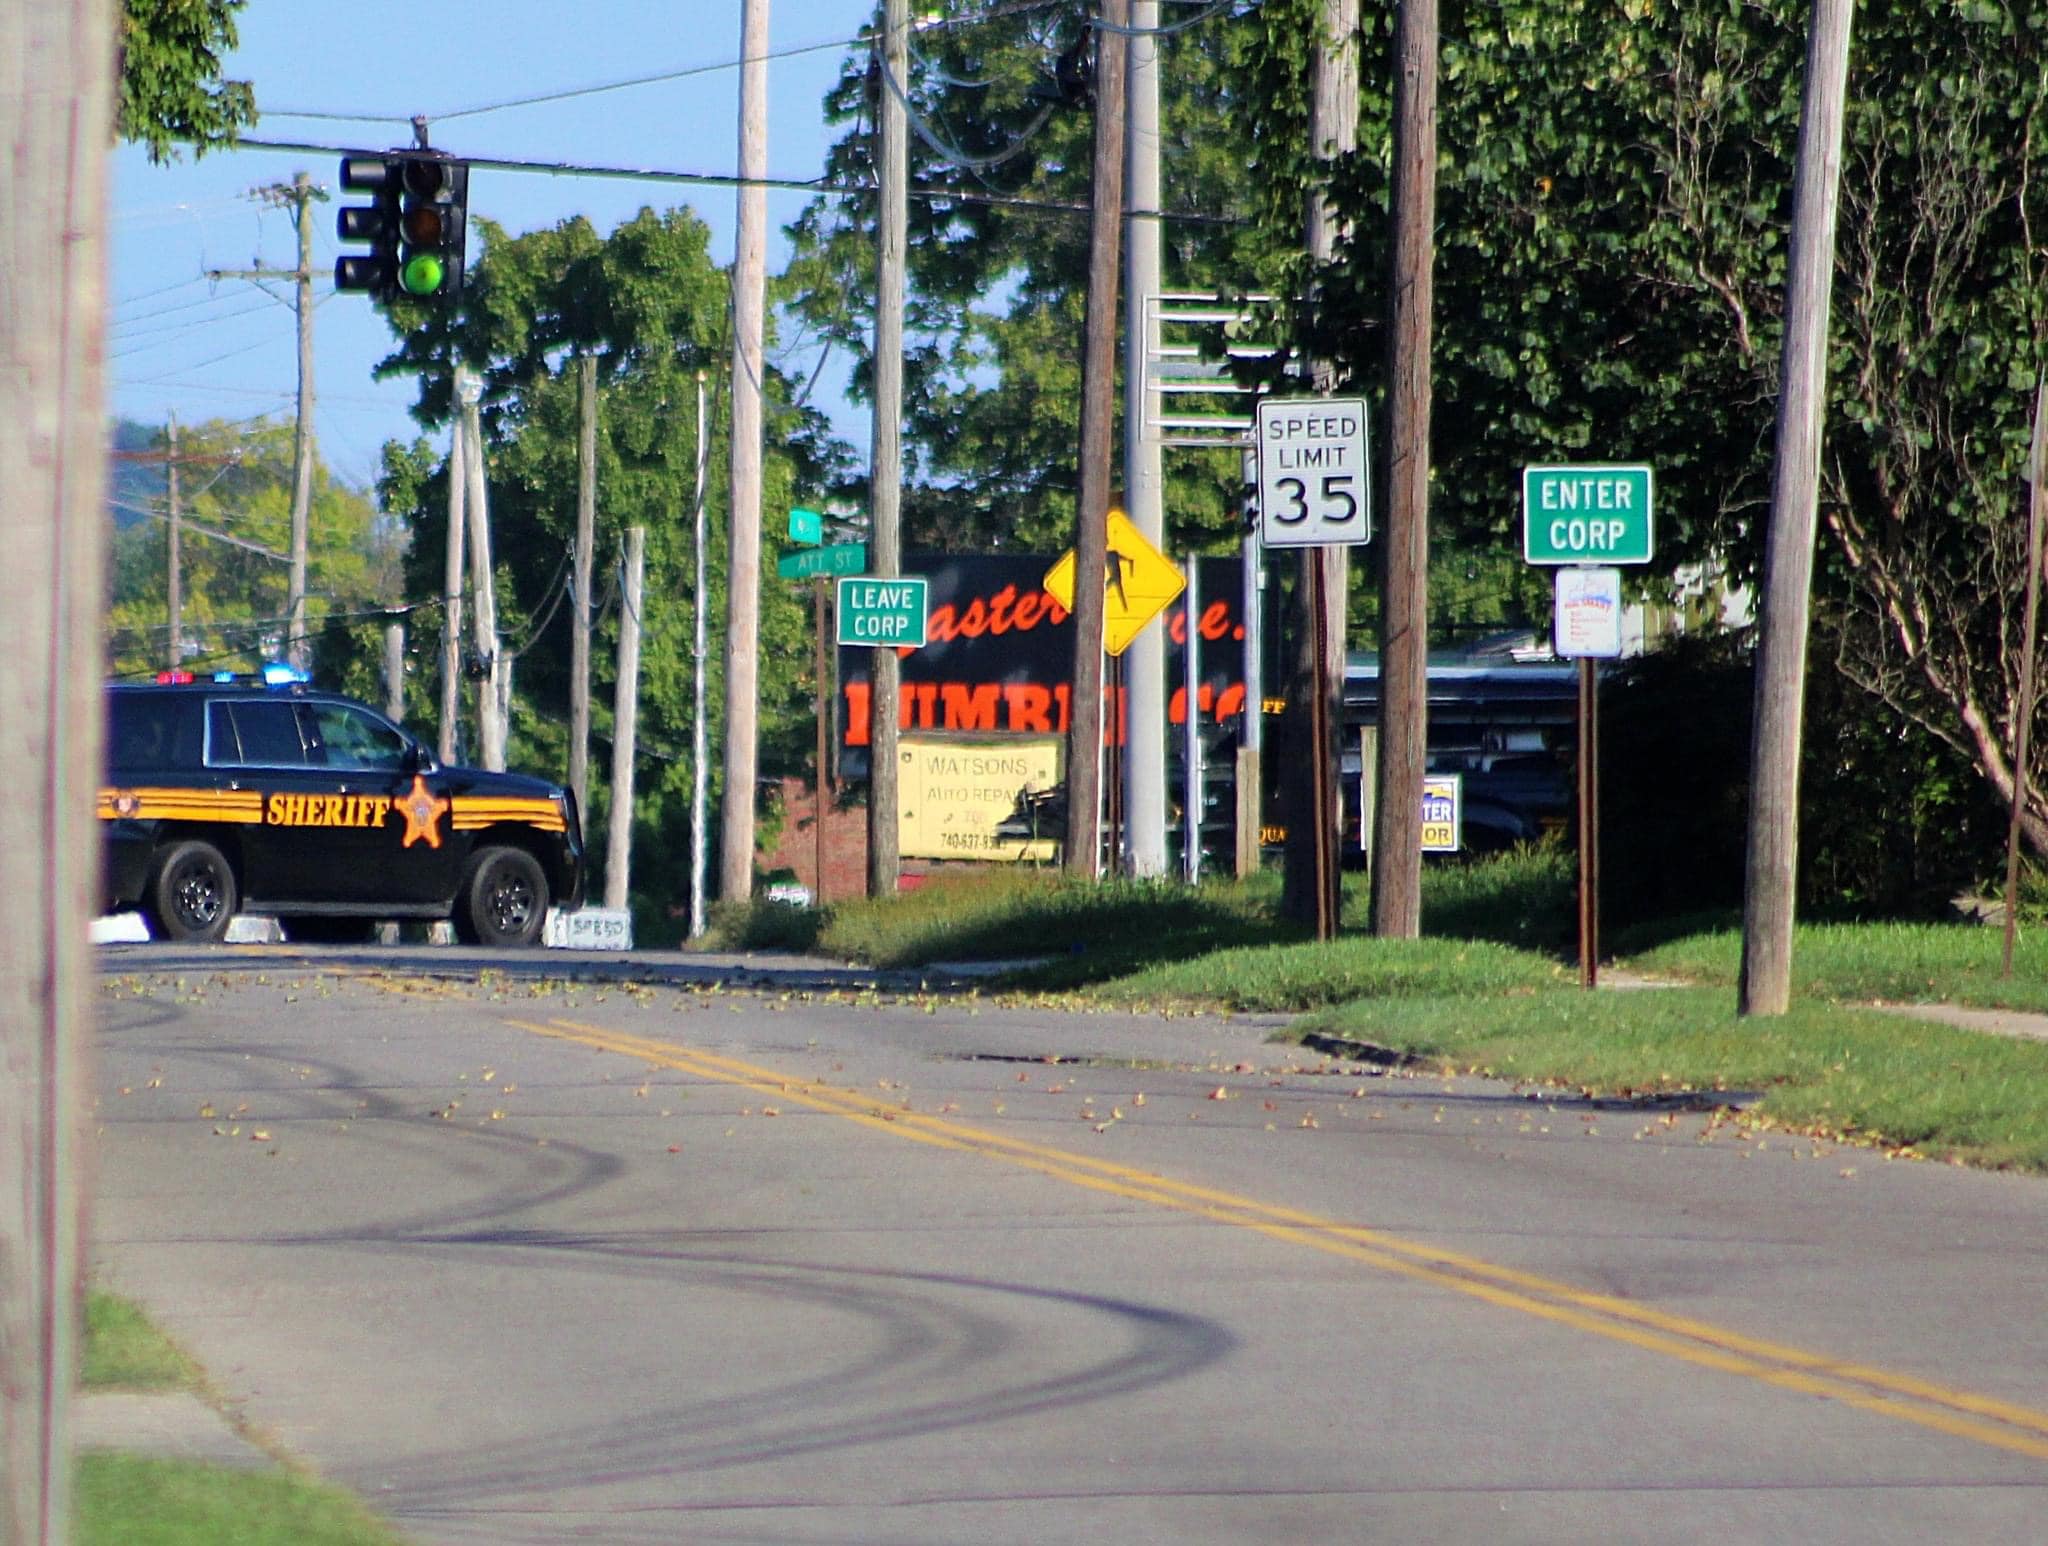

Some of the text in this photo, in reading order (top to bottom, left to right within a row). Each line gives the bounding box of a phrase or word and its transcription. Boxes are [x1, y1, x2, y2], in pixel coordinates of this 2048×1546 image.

[1269, 417, 1357, 440] SPEED
[1279, 447, 1347, 469] LIMIT
[1274, 475, 1358, 526] 35
[1541, 479, 1633, 510] ENTER
[1550, 519, 1626, 551] CORP
[851, 585, 914, 610] LEAVE
[854, 615, 909, 637] CORP
[926, 756, 1028, 776] WATSONS
[266, 793, 391, 828] SHERIFF
